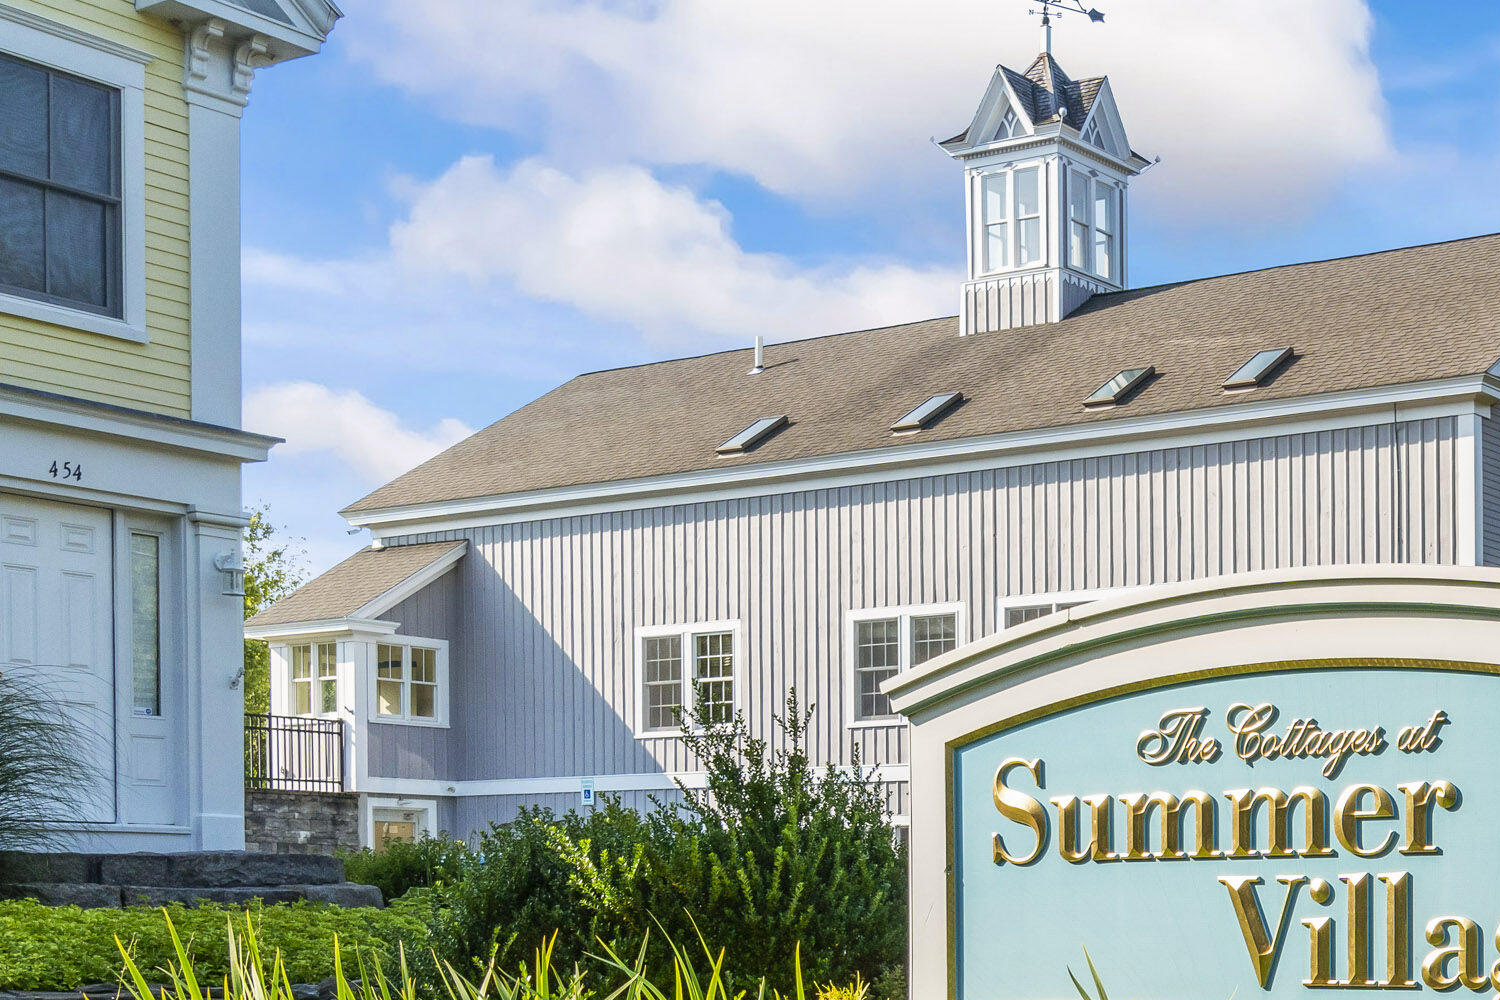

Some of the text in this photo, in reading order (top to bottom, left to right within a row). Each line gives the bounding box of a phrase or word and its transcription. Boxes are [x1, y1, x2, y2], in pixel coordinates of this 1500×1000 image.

[49, 460, 81, 481] 454
[1136, 702, 1451, 780] The Cottages at
[992, 757, 1461, 867] Summer
